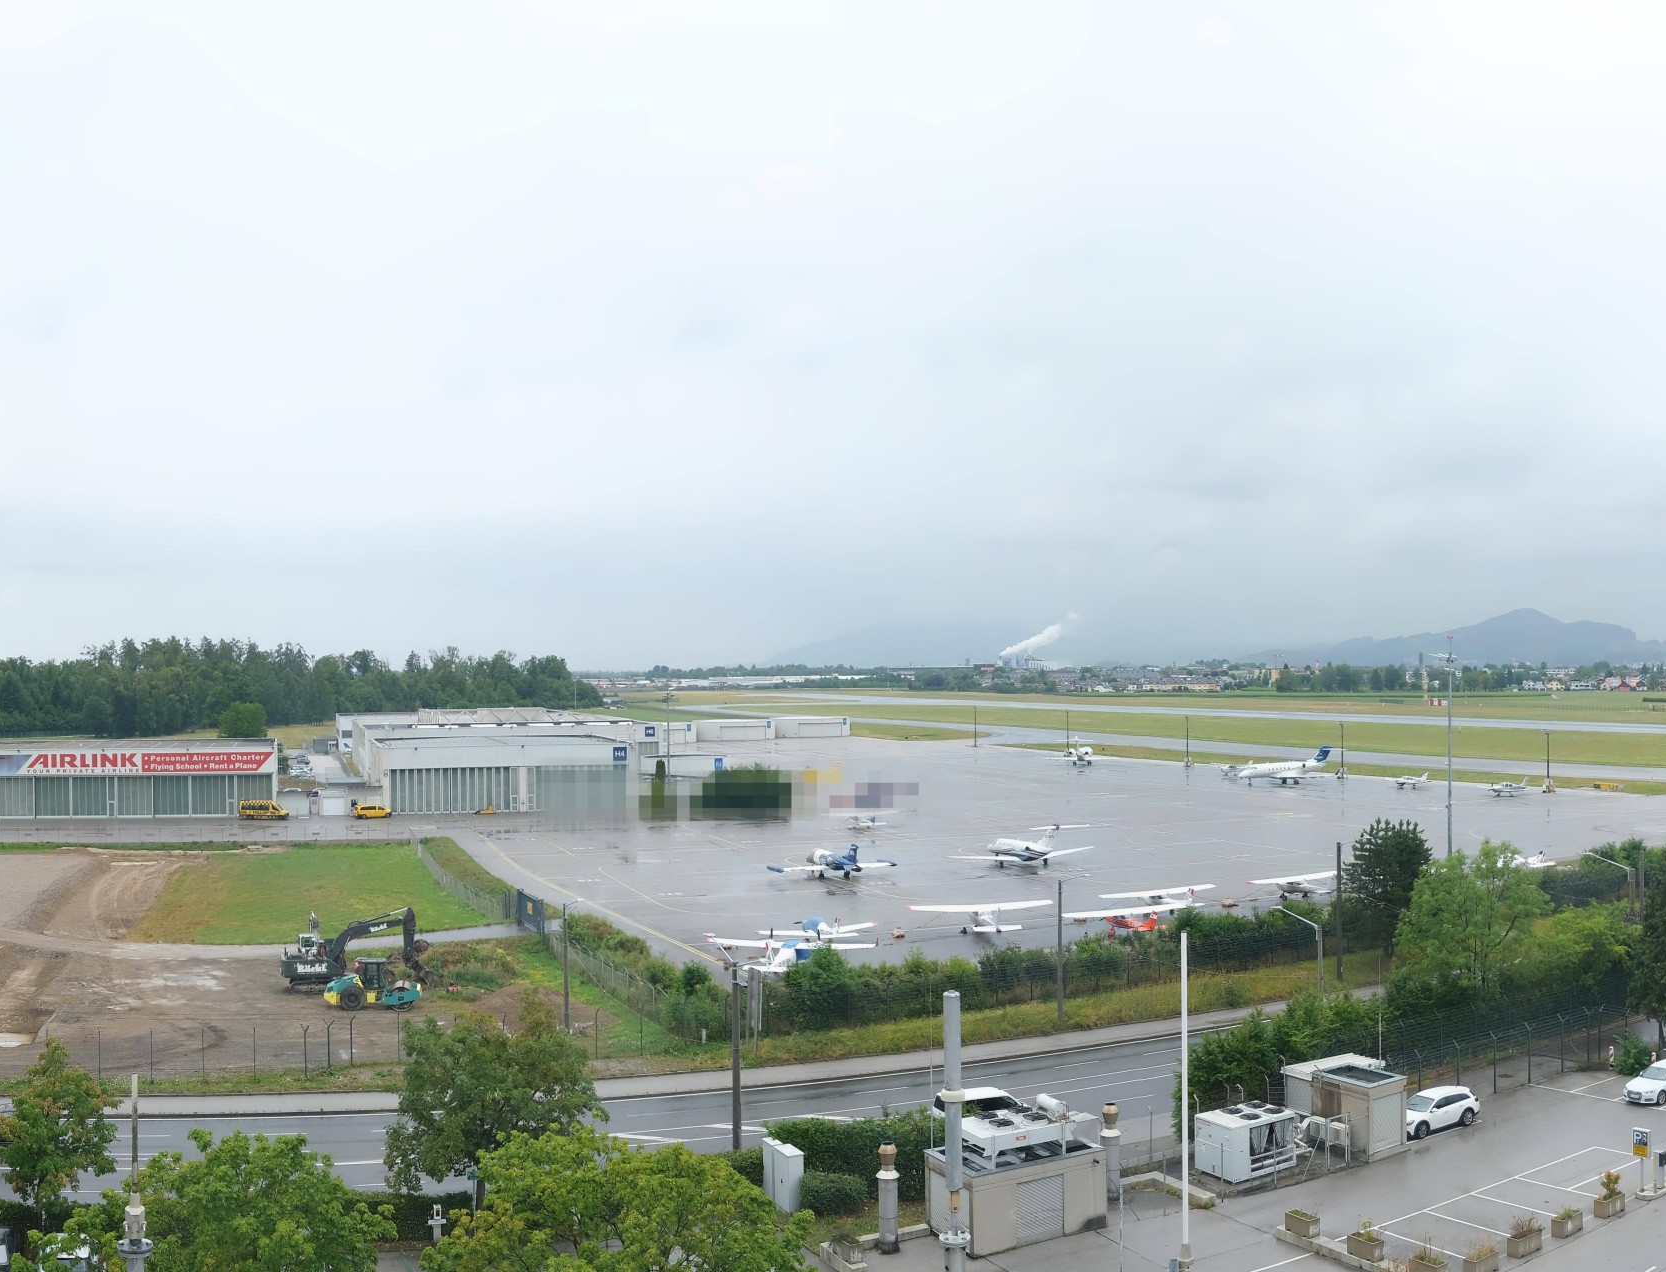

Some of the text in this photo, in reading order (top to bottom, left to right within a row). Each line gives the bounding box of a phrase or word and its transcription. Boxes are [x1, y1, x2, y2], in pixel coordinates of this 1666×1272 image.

[27, 753, 139, 768] AIRLINK
[150, 763, 174, 771] Flying
[1633, 1131, 1641, 1144] P
